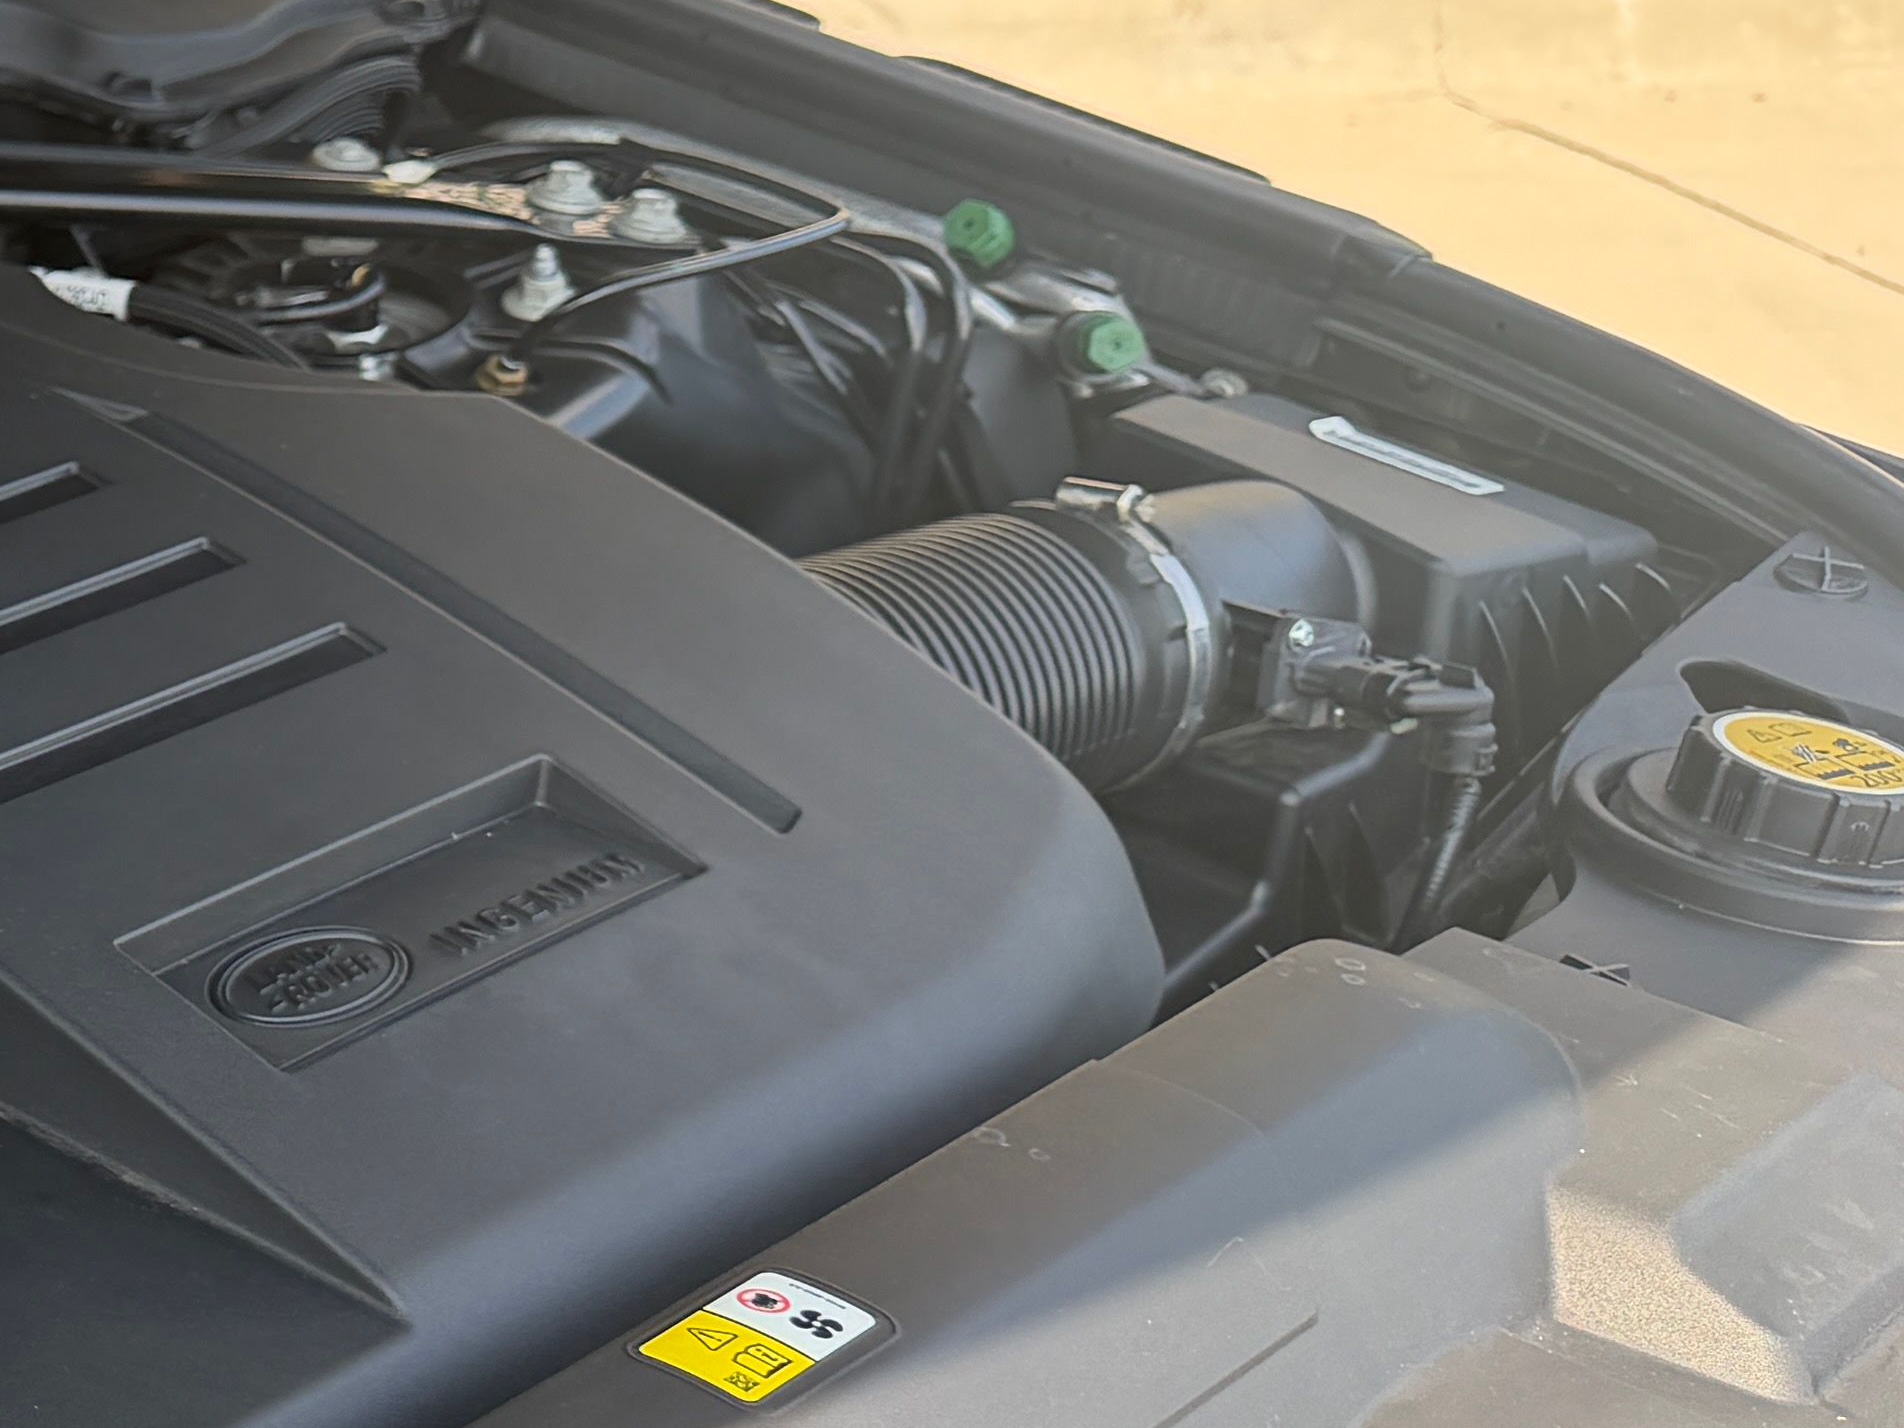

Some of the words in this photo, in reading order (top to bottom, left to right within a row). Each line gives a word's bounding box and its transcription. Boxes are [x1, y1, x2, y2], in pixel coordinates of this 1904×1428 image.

[1850, 770, 1904, 788] 200
[428, 851, 648, 956] INGENIUM
[244, 943, 332, 996] LAND
[285, 951, 379, 1010] ROVER
